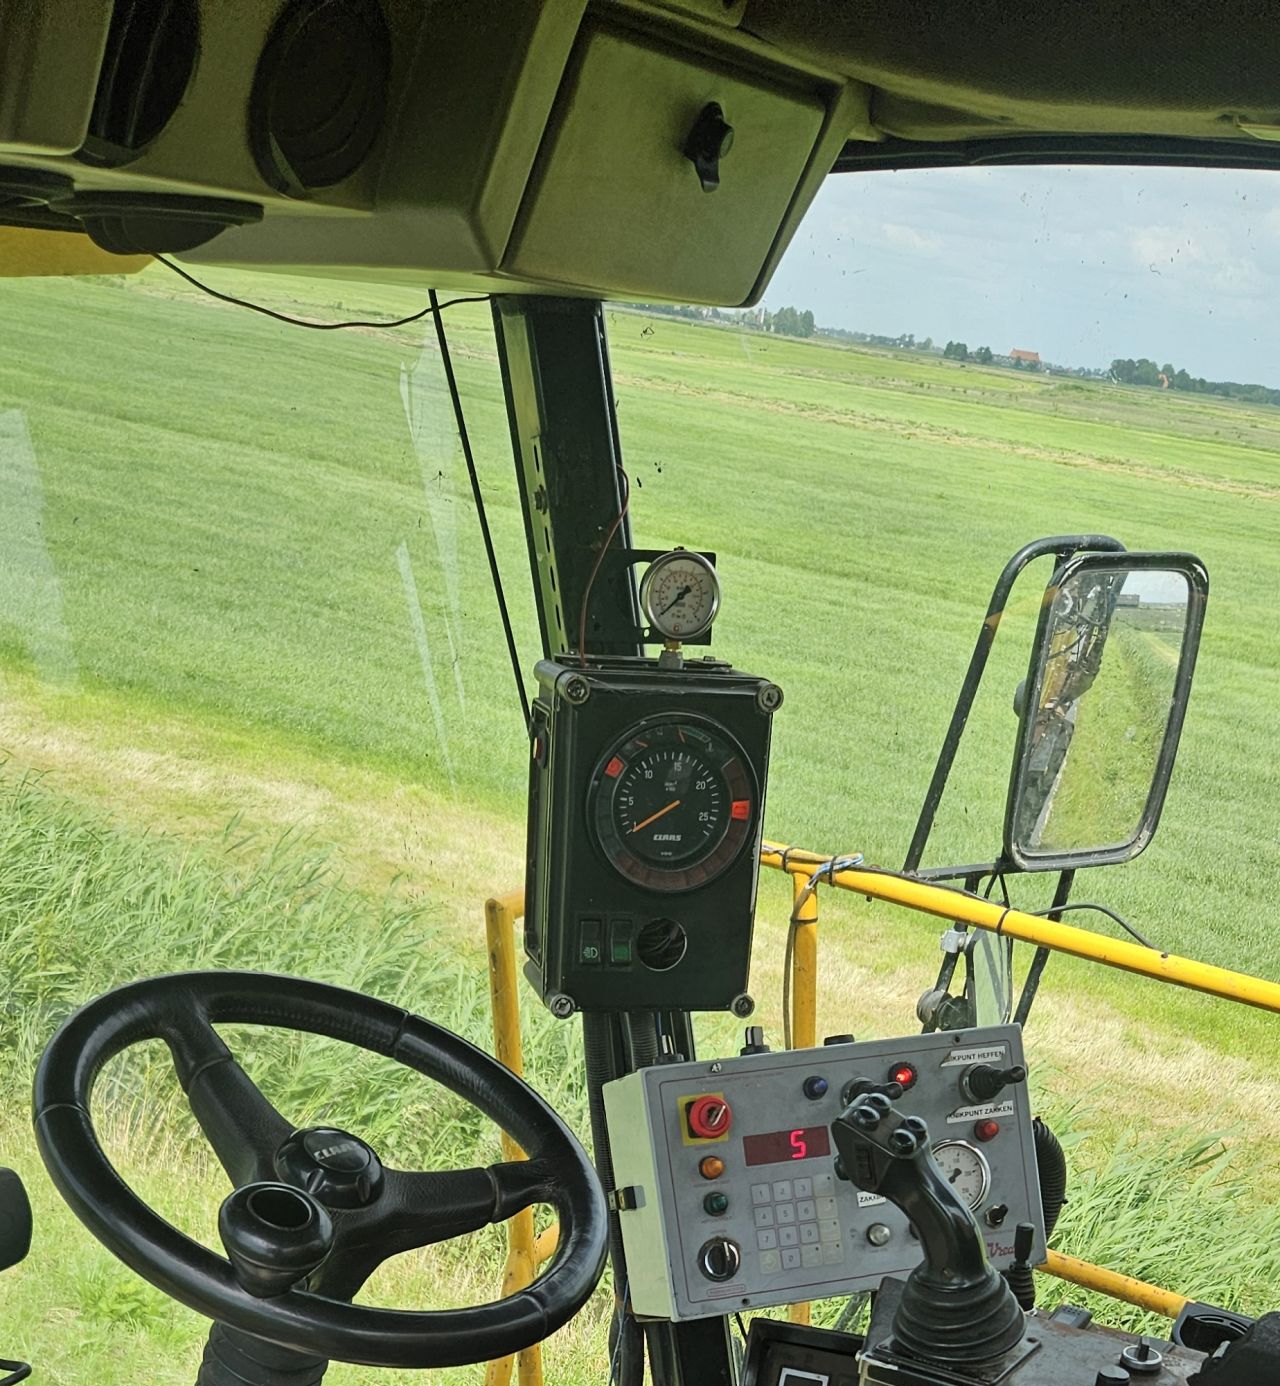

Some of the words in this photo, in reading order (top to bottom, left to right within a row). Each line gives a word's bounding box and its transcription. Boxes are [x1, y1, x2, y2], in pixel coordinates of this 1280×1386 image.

[674, 762, 682, 771] 15
[645, 770, 653, 779] 10
[695, 781, 705, 790] 20
[628, 796, 634, 806] 5
[699, 812, 708, 821] 25
[653, 834, 682, 842] CLAAS
[977, 1050, 1005, 1060] HEFFEN
[984, 1104, 1013, 1115] ZAKKEN
[790, 1129, 807, 1159] 5
